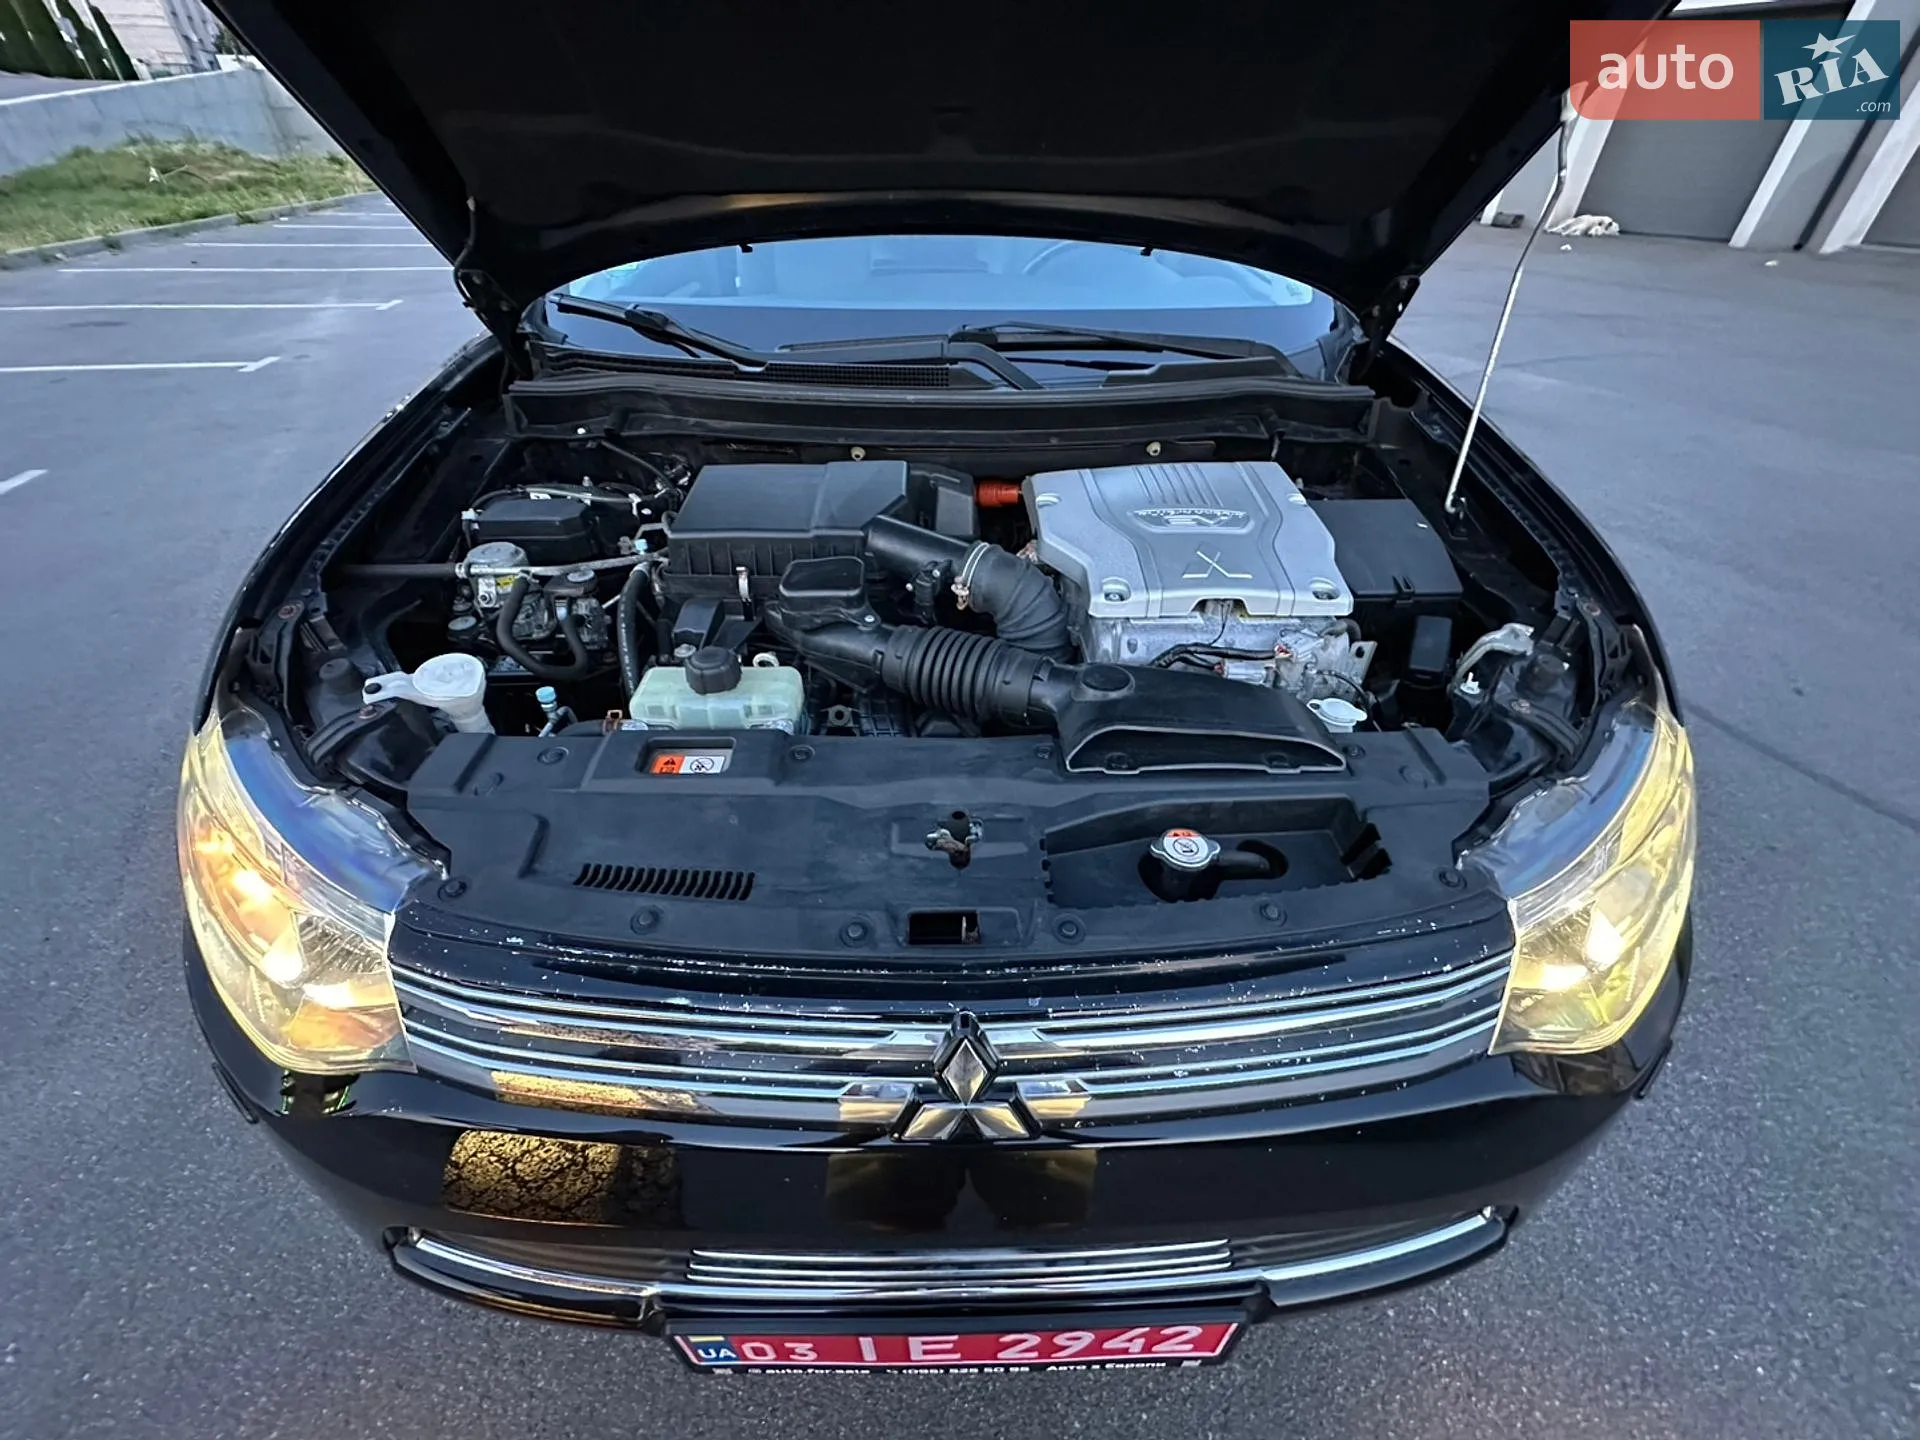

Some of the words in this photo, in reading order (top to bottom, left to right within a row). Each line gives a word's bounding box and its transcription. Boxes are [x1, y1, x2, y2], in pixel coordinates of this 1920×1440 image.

[697, 1348, 738, 1359] UA
[741, 1342, 819, 1361] 03
[997, 1325, 1203, 1360] 2942
